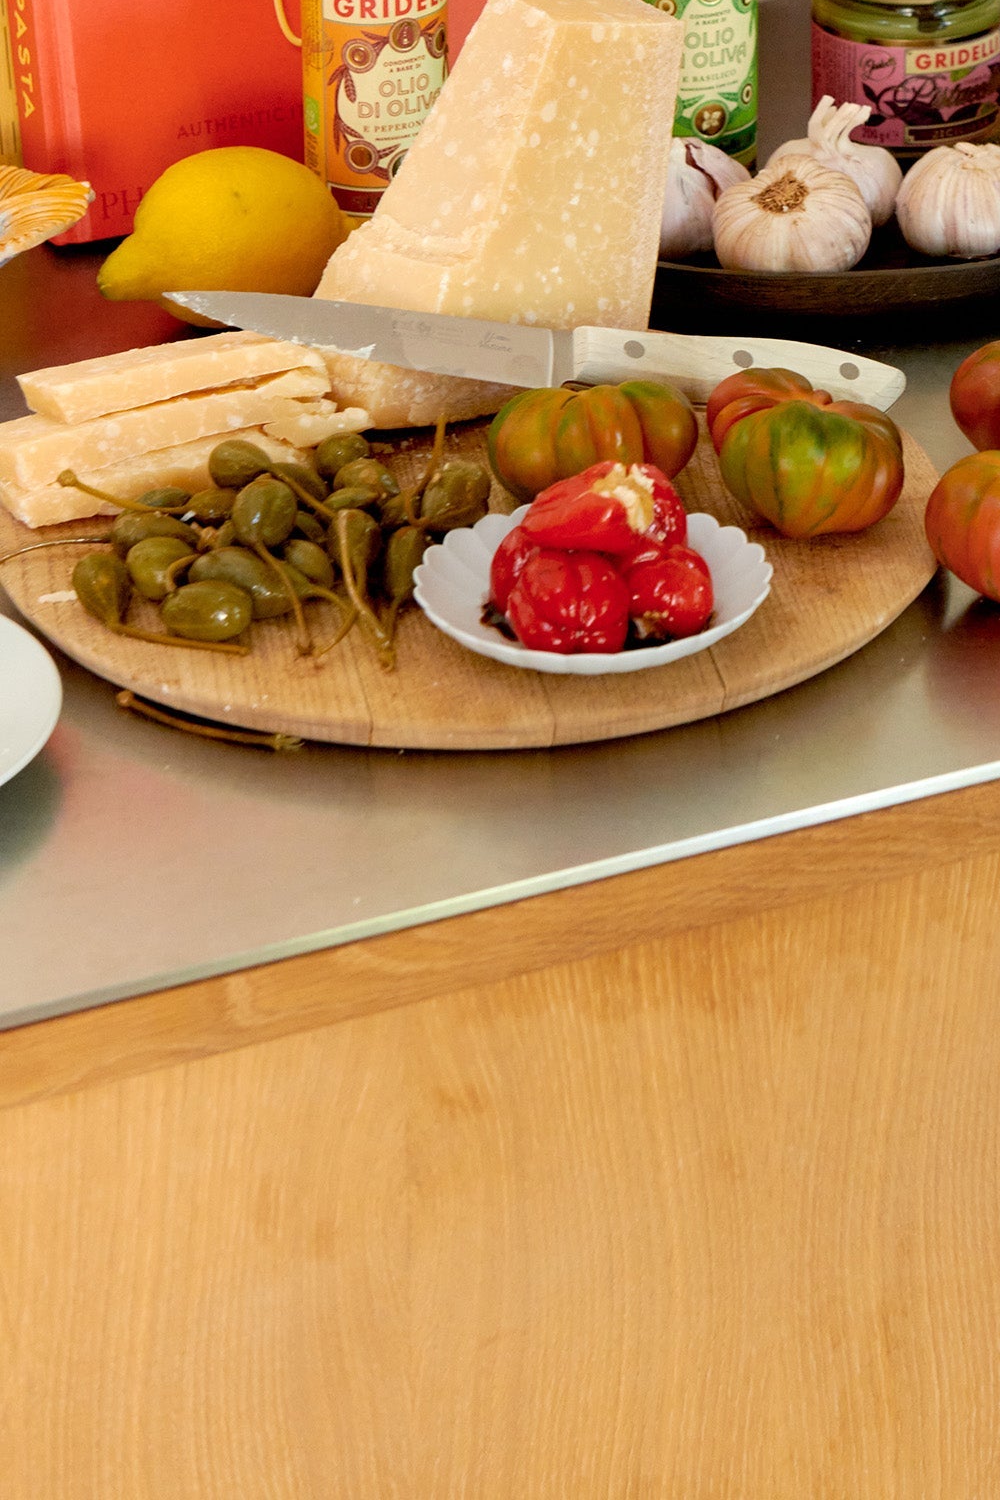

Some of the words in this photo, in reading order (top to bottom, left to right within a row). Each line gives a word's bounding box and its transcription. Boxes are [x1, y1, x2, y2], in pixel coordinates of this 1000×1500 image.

[684, 26, 735, 49] OLIO
[692, 41, 747, 69] OLIVA
[378, 73, 430, 98] OLIO
[177, 107, 286, 139] AUTHENTIC
[357, 102, 381, 119] DI
